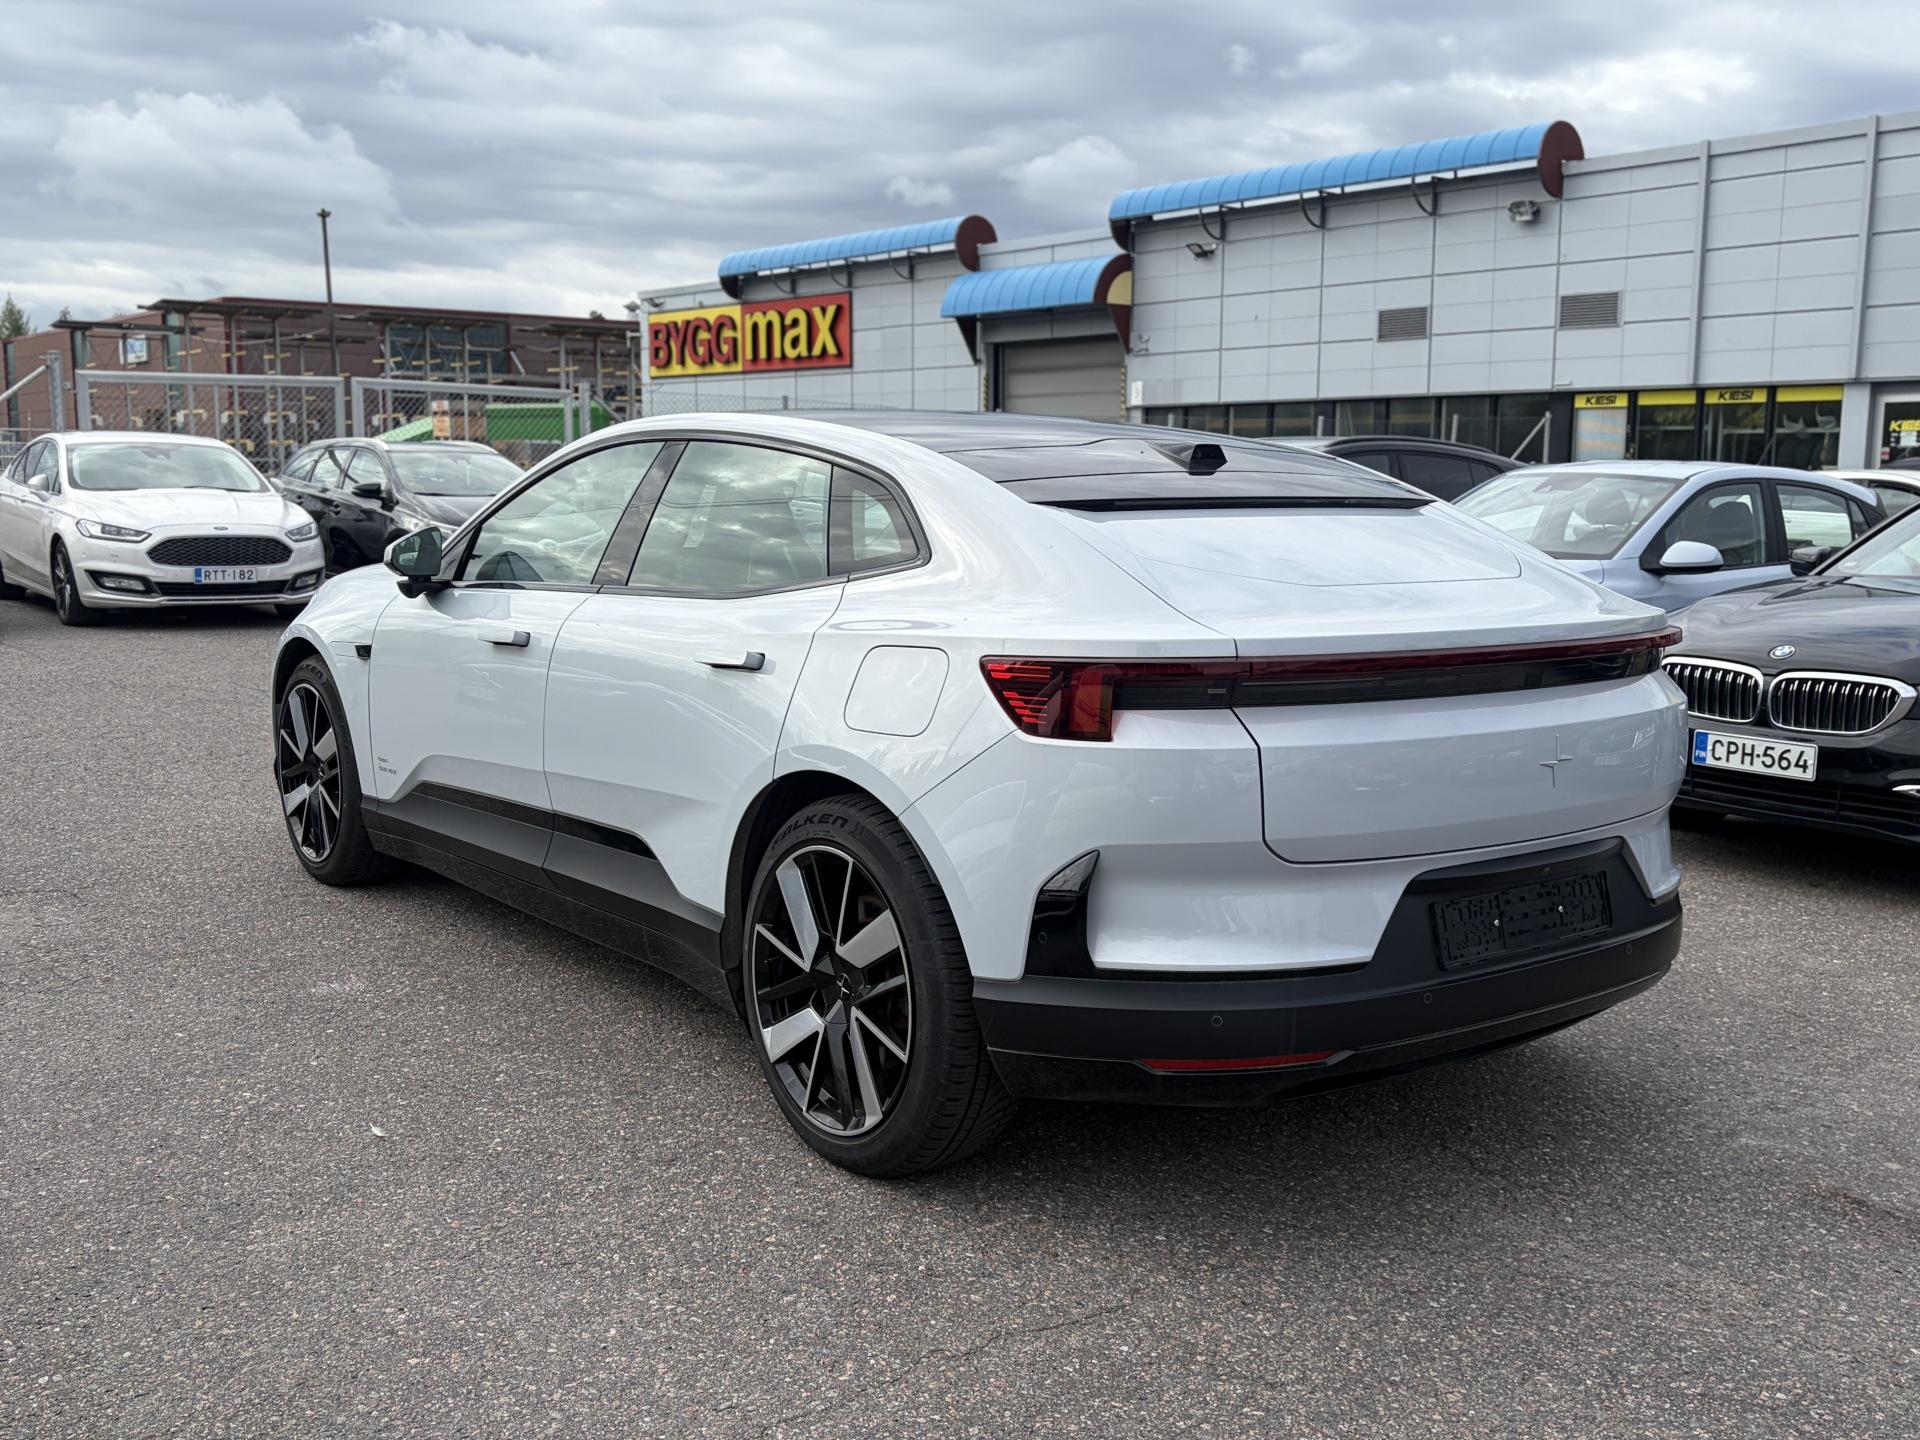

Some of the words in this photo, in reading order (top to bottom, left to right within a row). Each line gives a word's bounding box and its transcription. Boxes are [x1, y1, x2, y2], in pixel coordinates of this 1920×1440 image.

[650, 314, 738, 368] BYGG
[745, 304, 841, 360] max
[1585, 395, 1617, 405] KIESI
[1717, 390, 1753, 401] KIESI
[204, 569, 254, 581] RTT-182
[1695, 750, 1707, 758] FIN
[1711, 739, 1810, 774] CPH-564
